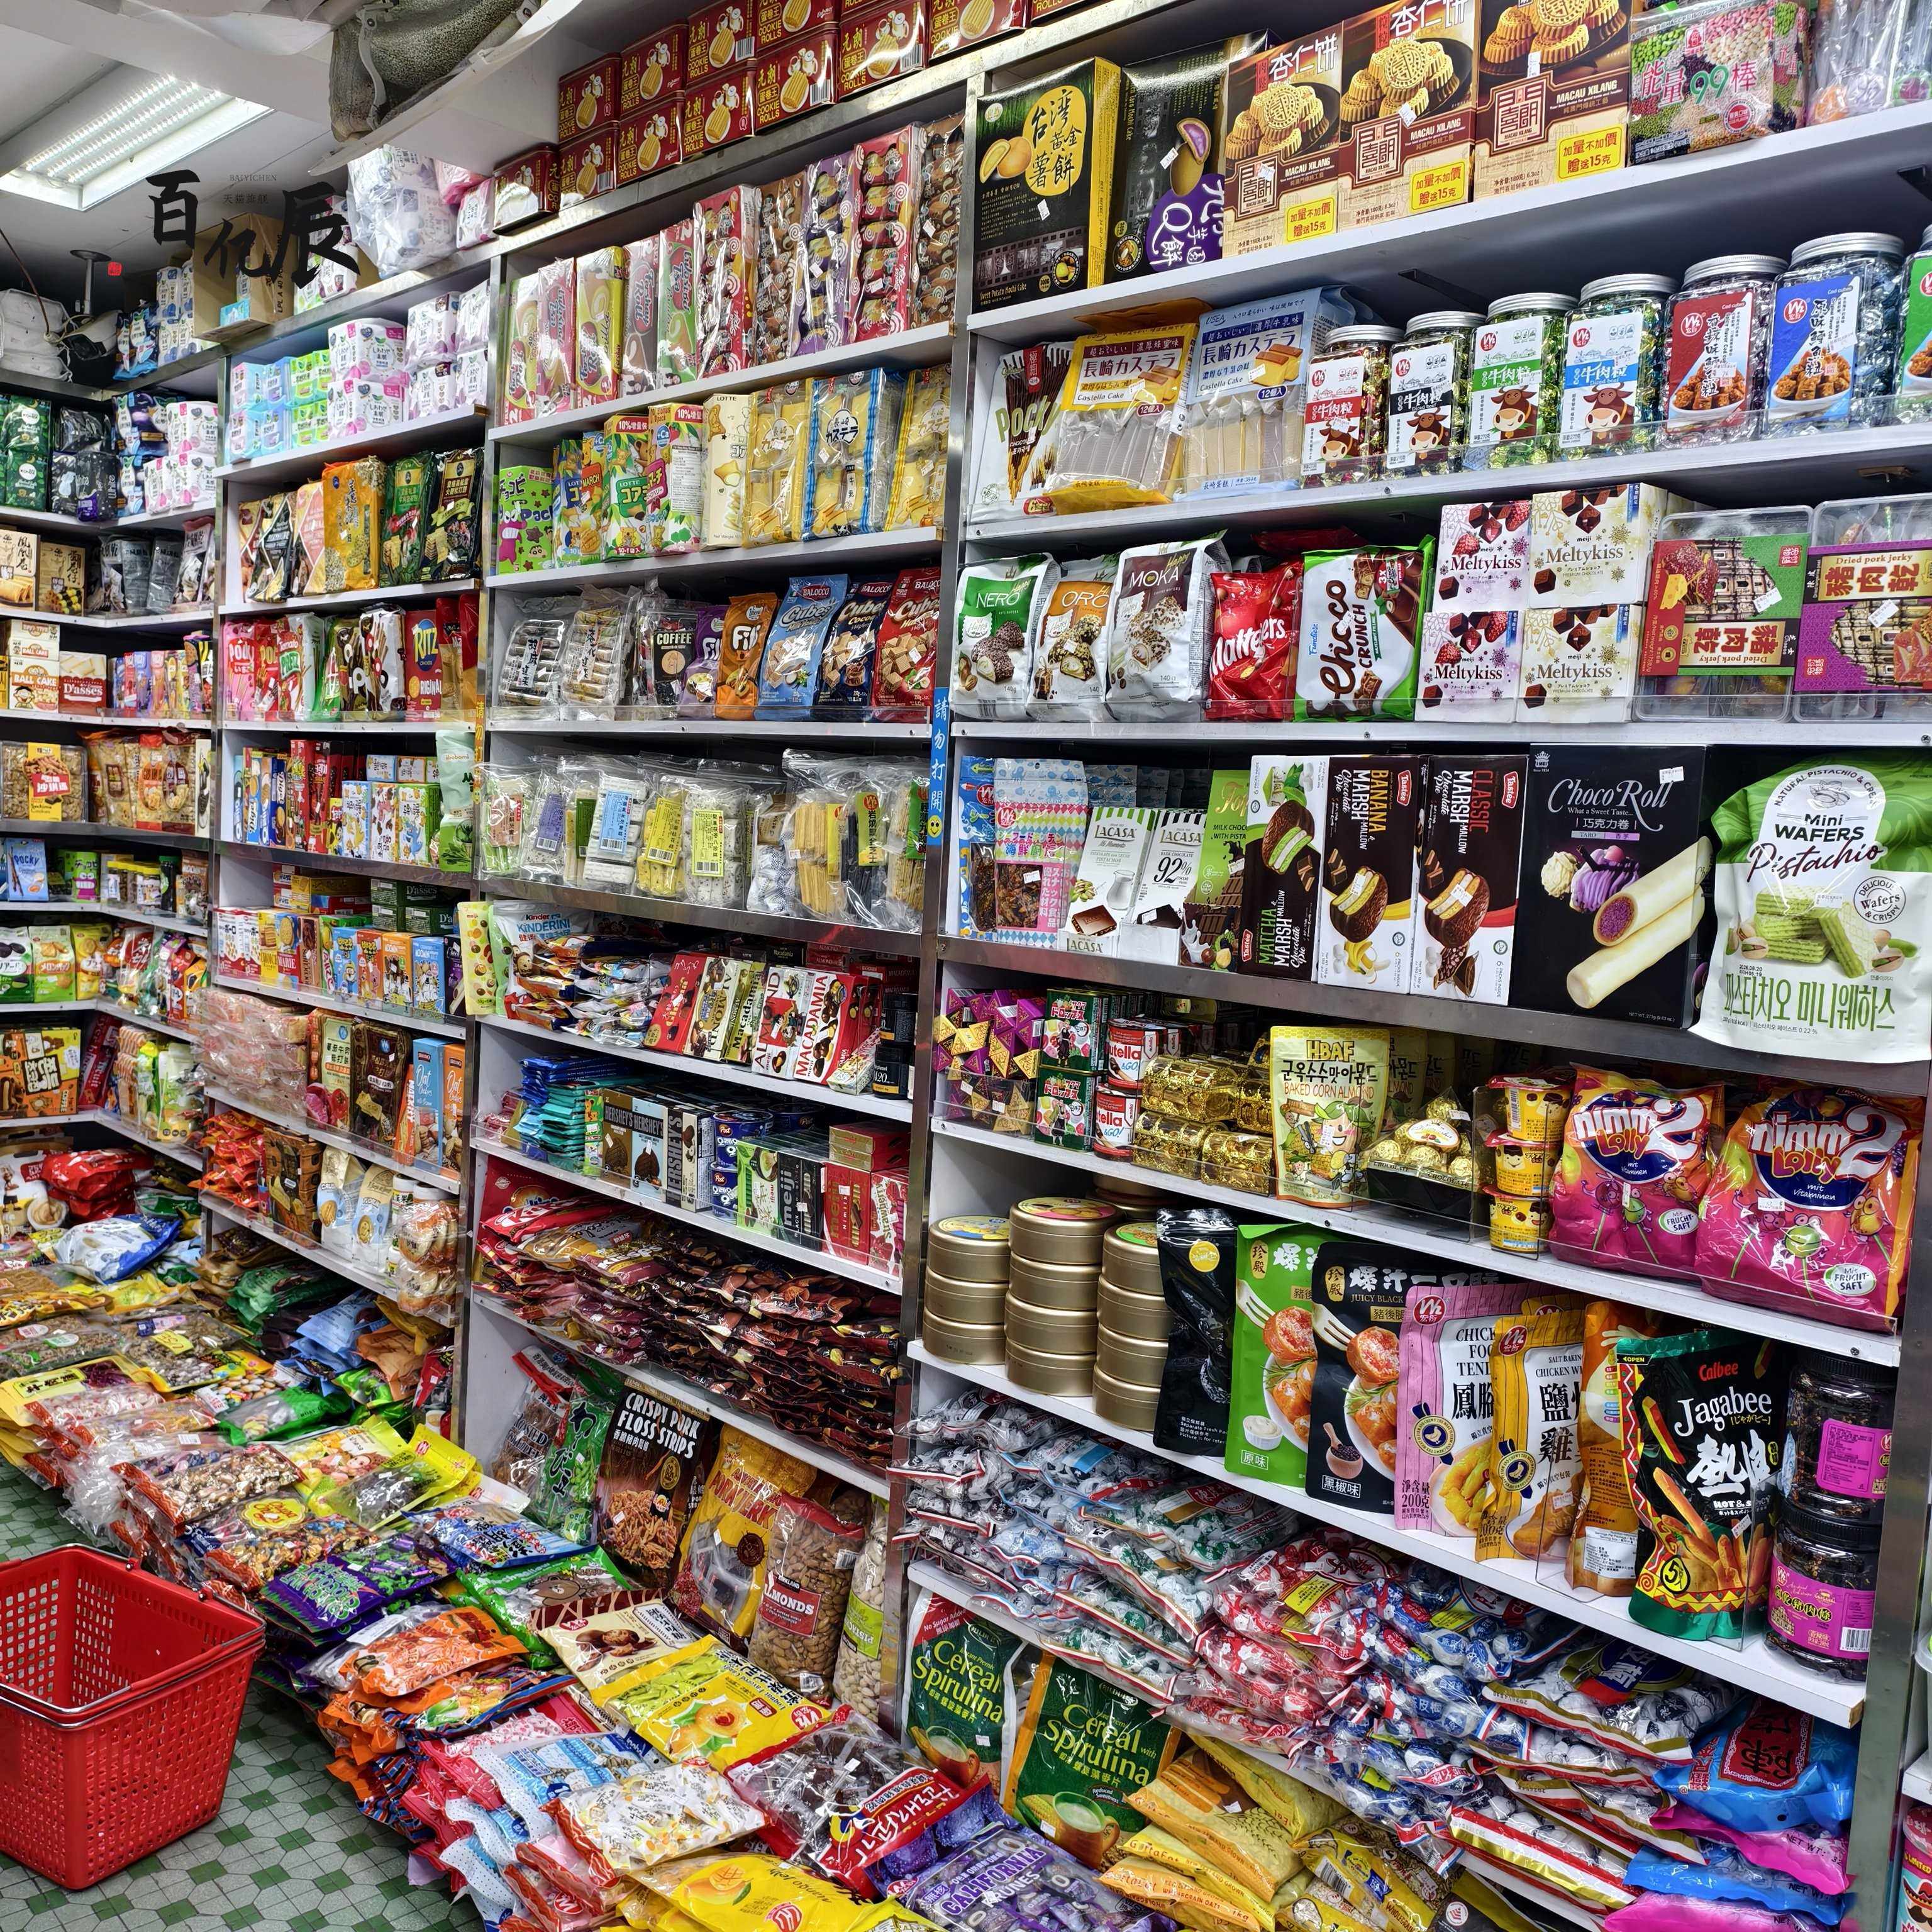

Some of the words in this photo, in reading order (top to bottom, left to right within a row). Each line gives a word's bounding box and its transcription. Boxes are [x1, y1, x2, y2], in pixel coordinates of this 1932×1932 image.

[758, 19, 782, 37] COOKIE
[760, 29, 782, 45] ROLLS
[621, 87, 640, 105] COOKIE
[1557, 89, 1585, 104] MACAU
[1587, 79, 1618, 97] XILANG
[623, 97, 640, 111] ROLLS
[757, 100, 780, 117] COOKIE
[759, 109, 780, 125] ROLLS
[1410, 128, 1434, 141] MACAU
[1436, 118, 1462, 135] XILANG
[1563, 131, 1618, 158] 加量不加價
[1285, 165, 1307, 178] MACAU
[1307, 157, 1331, 174] XILANG
[1567, 153, 1611, 174] 贈送15克
[1415, 167, 1462, 191] 加量不加價
[1418, 187, 1457, 206] 贈送15克
[1290, 201, 1331, 223] 加量不加價
[1200, 378, 1228, 392] Castella
[1230, 376, 1243, 385] Cake
[1260, 388, 1284, 400] 12個入
[1140, 405, 1160, 414] 12個入
[1317, 401, 1354, 417] 牛肉粒
[834, 418, 850, 427] 長崎
[826, 425, 858, 445] カステラ
[582, 473, 601, 488] MARCH
[1545, 543, 1624, 564] Meltykiss
[1836, 555, 1862, 565] Dried
[1864, 555, 1885, 567] pork
[1887, 553, 1913, 565] jerky
[1450, 555, 1522, 573] Meltykiss
[1131, 567, 1179, 588] MOKA
[802, 586, 830, 596] BALOCCO
[862, 584, 892, 593] BALOCCO
[976, 592, 1021, 609] NERO
[780, 604, 835, 628] Cubes
[413, 622, 438, 661] RITZ
[657, 633, 692, 645] COFFEE
[1352, 604, 1374, 669] CRUNCH
[280, 651, 301, 676] PRETZ
[1536, 663, 1613, 682] Meltykiss
[13, 674, 32, 687] BALL
[35, 675, 57, 686] CAKE
[1434, 665, 1503, 682] Meltykiss
[63, 682, 104, 698] D'asses
[928, 699, 950, 813] 請勿打開
[1341, 769, 1350, 814] Chocolate
[1352, 769, 1371, 820] MARSH
[1547, 778, 1616, 813] Choco
[1370, 769, 1387, 834] BANANA
[1468, 769, 1493, 834] CLASSIC
[1582, 818, 1629, 830] 巧克力卷
[1804, 813, 1844, 826] Mini
[1094, 824, 1136, 840] LACASA
[1159, 828, 1202, 845] LACASA
[1360, 821, 1368, 850] MALLOW
[1774, 823, 1865, 842] WAFERS
[1747, 838, 1884, 882] Pistachio
[406, 885, 438, 896] D'asses
[1860, 892, 1901, 909] Wafers
[525, 913, 550, 921] Kinder
[1872, 904, 1901, 921] CRISPY
[516, 919, 571, 933] KINDERINI
[1067, 938, 1103, 953] LACASA
[1258, 908, 1277, 965] MATCHA
[1274, 911, 1292, 967] MARSH
[1290, 925, 1301, 968] Chocolate
[1297, 945, 1306, 963] Pie
[277, 954, 297, 970] MARIE
[1724, 973, 1792, 1022] 피스타치오
[1797, 981, 1896, 1031] 미니웨하스
[1049, 1006, 1086, 1021] ドロップス
[796, 975, 829, 1077] MACADAMIA
[1306, 1039, 1355, 1061] HBAF
[416, 1063, 433, 1088] Oat
[1282, 1059, 1379, 1085] 군옥수수맛아몬드
[447, 1069, 462, 1095] Oat
[1284, 1082, 1311, 1096] BAKED
[1313, 1084, 1336, 1097] CORN
[1338, 1085, 1374, 1100] ALMOND
[1043, 1084, 1081, 1100] ドロップス
[604, 1104, 633, 1129] HERSHEY'S
[719, 1125, 733, 1134] Post
[1597, 1131, 1652, 1158] Lolly
[1772, 1149, 1841, 1181] Lolly
[714, 1174, 726, 1183] Post
[1807, 1182, 1824, 1192] mit
[1792, 1188, 1836, 1203] Vitaminen
[1666, 1214, 1694, 1226] FRUCHT-
[1672, 1222, 1691, 1232] SAFT
[1252, 1244, 1267, 1275] 珍殿
[1328, 1269, 1343, 1299] 珍殿
[1833, 1272, 1870, 1284] FRUCHT-
[1840, 1281, 1863, 1291] SAFT
[1351, 1293, 1374, 1303] JUICY
[1376, 1294, 1404, 1304] BLACK
[1699, 1360, 1739, 1382] Calbee
[626, 1392, 669, 1423] CRISPY
[670, 1410, 701, 1440] PORK
[1674, 1385, 1773, 1439] Jagabee
[618, 1410, 657, 1440] FLOSS
[657, 1427, 696, 1459] STRIPS
[1243, 1453, 1267, 1468] 原味
[1324, 1476, 1360, 1496] 黑椒味
[1402, 1479, 1430, 1496] 淨含量
[1402, 1493, 1430, 1509] 200克
[932, 1618, 949, 1628] Sugar
[950, 1608, 966, 1620] Added
[934, 1640, 1000, 1694] Cereal
[913, 1655, 1002, 1724] Spirulina
[1062, 1703, 1140, 1755] Cereal
[1140, 1746, 1157, 1760] with
[1045, 1719, 1150, 1787] Spirulina
[940, 1845, 1046, 1916] CALIFORNIA
